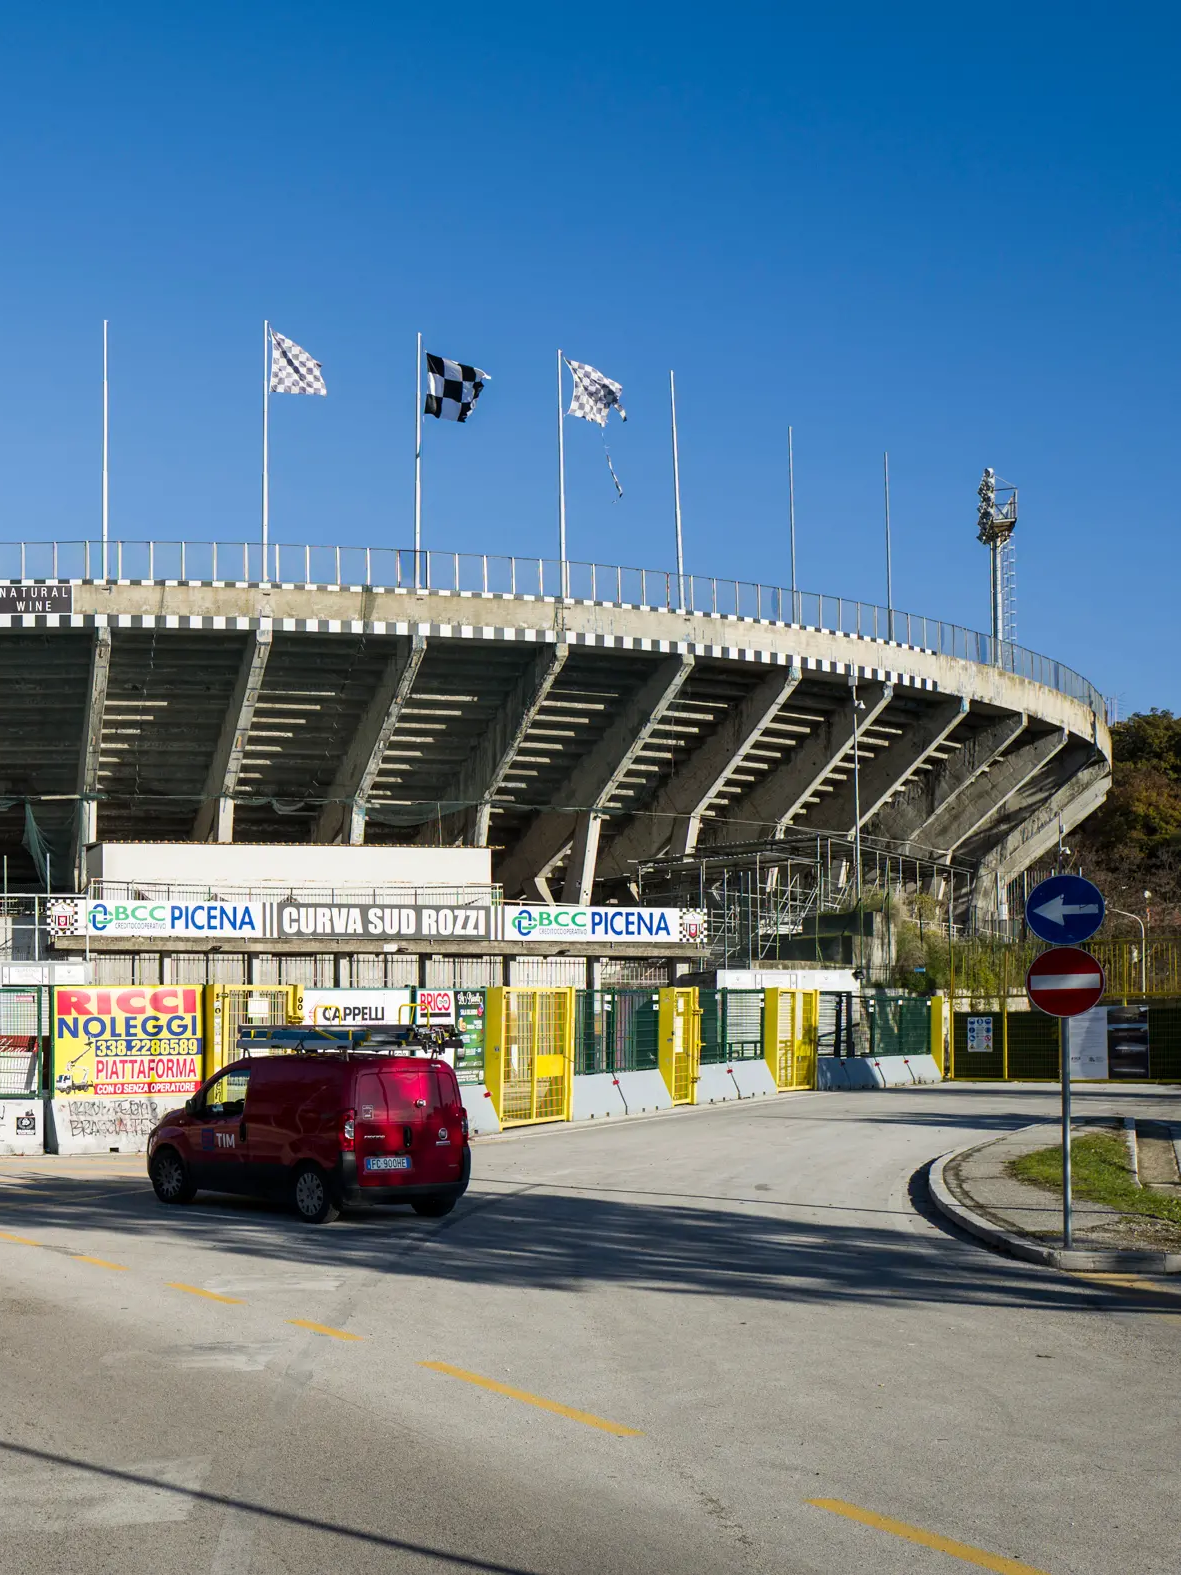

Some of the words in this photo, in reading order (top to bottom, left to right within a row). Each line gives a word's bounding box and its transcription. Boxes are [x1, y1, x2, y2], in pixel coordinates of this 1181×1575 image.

[0, 587, 68, 598] NATURAL
[17, 601, 52, 612] WINE
[115, 905, 166, 921] BCC
[170, 905, 255, 931] PICENA
[283, 907, 364, 934] CURVA
[368, 909, 418, 934] SUD
[421, 910, 485, 936] ROZZI
[539, 911, 586, 927] BCC
[591, 911, 670, 936] PICENA
[57, 989, 196, 1015] RICCI
[420, 993, 450, 1011] BRICO
[323, 1006, 384, 1021] CAPPELLI
[58, 1015, 197, 1038] NOLEGGI
[97, 1039, 198, 1056] 338.2286589
[96, 1058, 197, 1080] PIATTAFORMA
[97, 1084, 115, 1094] CON
[116, 1084, 121, 1093] O
[124, 1083, 148, 1092] SENZA
[151, 1082, 195, 1092] OPERATORE
[216, 1133, 235, 1148] TIM
